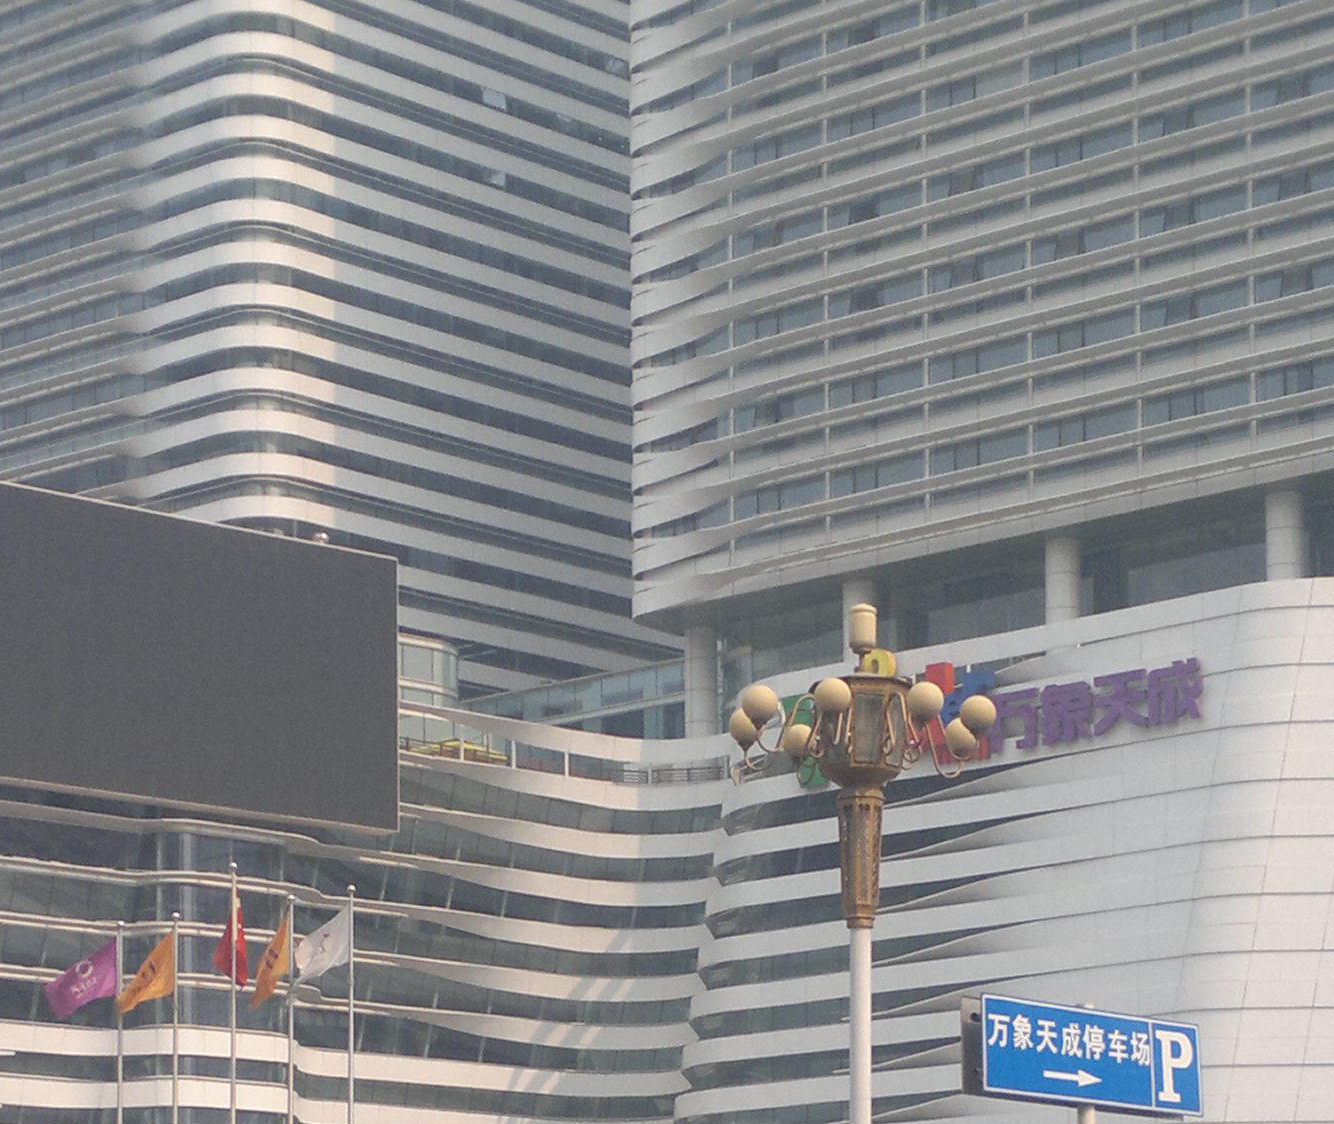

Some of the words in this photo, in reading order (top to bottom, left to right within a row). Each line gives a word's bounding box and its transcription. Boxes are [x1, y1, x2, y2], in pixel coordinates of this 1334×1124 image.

[991, 656, 1204, 756] 万象天成
[987, 1013, 1152, 1067] 万象天成停车场
[1155, 1029, 1194, 1103] P
